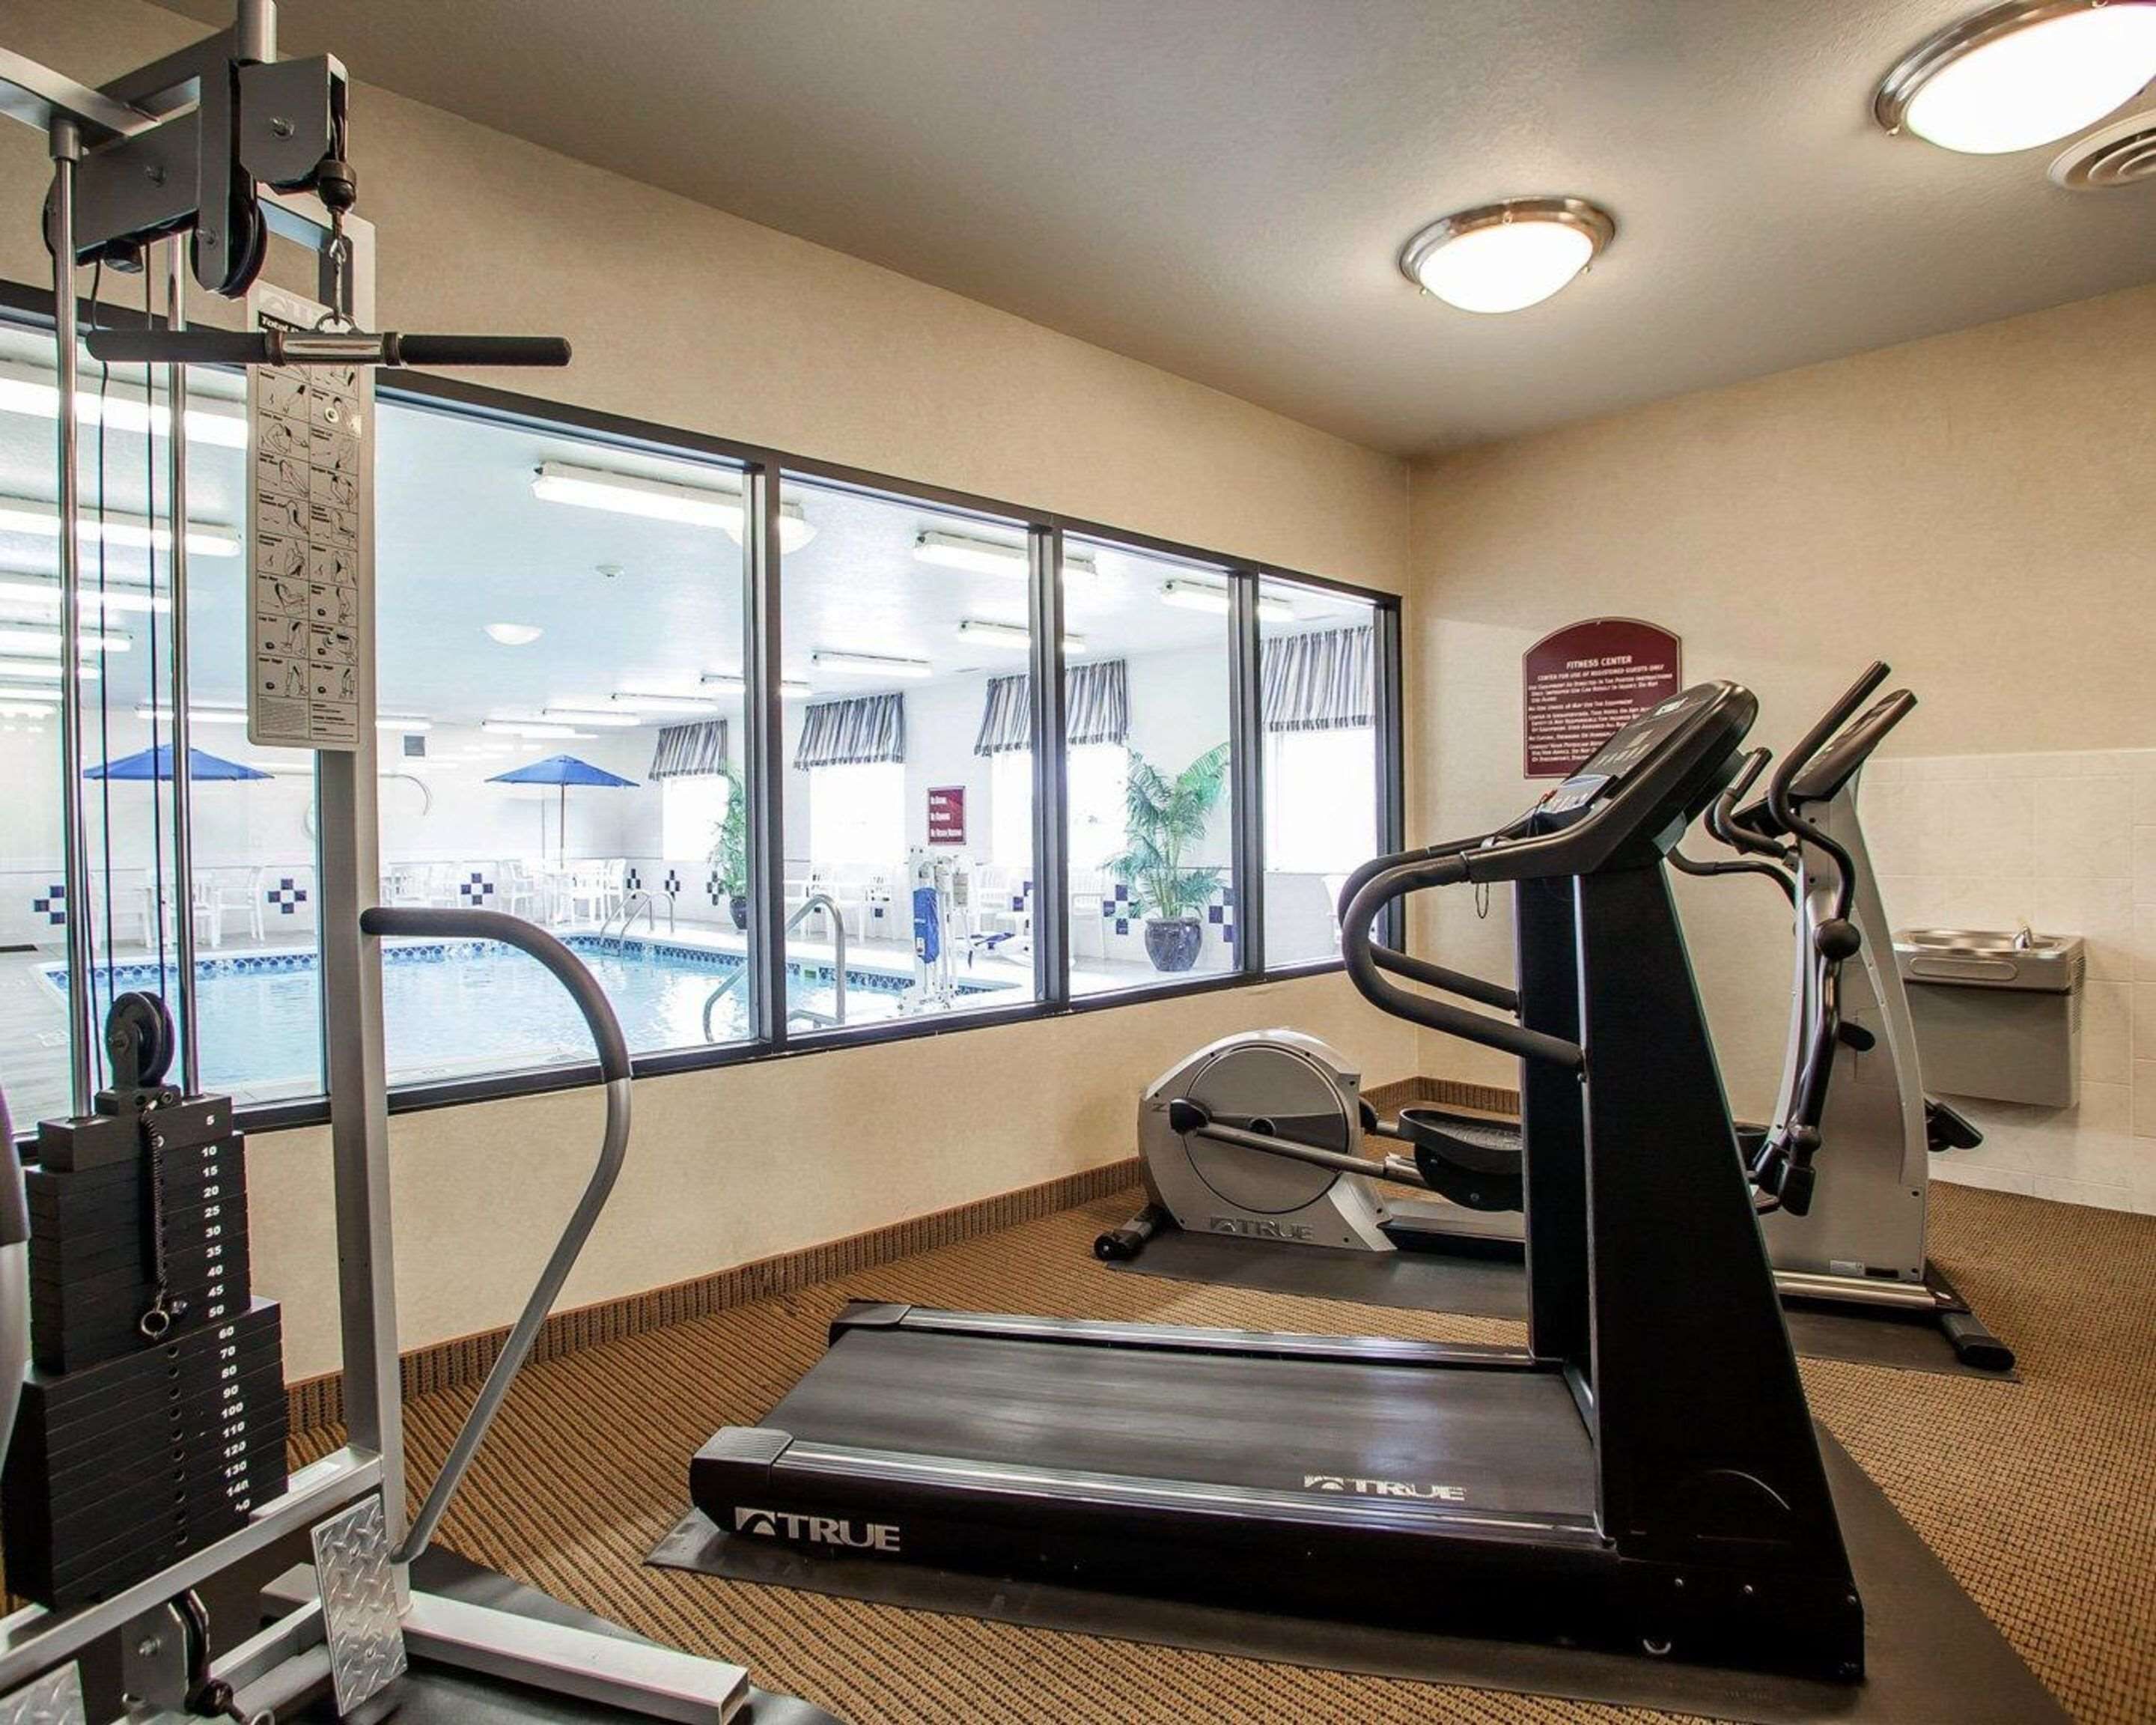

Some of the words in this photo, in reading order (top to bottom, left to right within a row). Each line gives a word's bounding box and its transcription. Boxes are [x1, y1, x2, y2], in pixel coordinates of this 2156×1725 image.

[1566, 659, 1599, 670] FITNESS
[1601, 655, 1632, 667] CENTER
[1538, 674, 1557, 682] CENTER
[206, 1115, 215, 1125] 5
[201, 1146, 217, 1157] 10
[202, 1165, 218, 1177] 15
[203, 1185, 219, 1198] 20
[204, 1205, 221, 1217] 25
[205, 1225, 221, 1238] 30
[1235, 1218, 1314, 1240] TRUE
[206, 1245, 222, 1258] 35
[207, 1265, 223, 1277] 40
[207, 1284, 224, 1297] 45
[208, 1304, 225, 1318] 50
[219, 1326, 234, 1339] 60
[220, 1345, 236, 1360] 70
[222, 1365, 237, 1378] 80
[223, 1384, 239, 1399] 90
[222, 1402, 244, 1419] 100
[222, 1421, 246, 1438] 110
[224, 1440, 246, 1458] 120
[225, 1460, 248, 1478] 130
[1345, 1478, 1466, 1500] TRUE
[777, 1512, 901, 1552] TRUE
